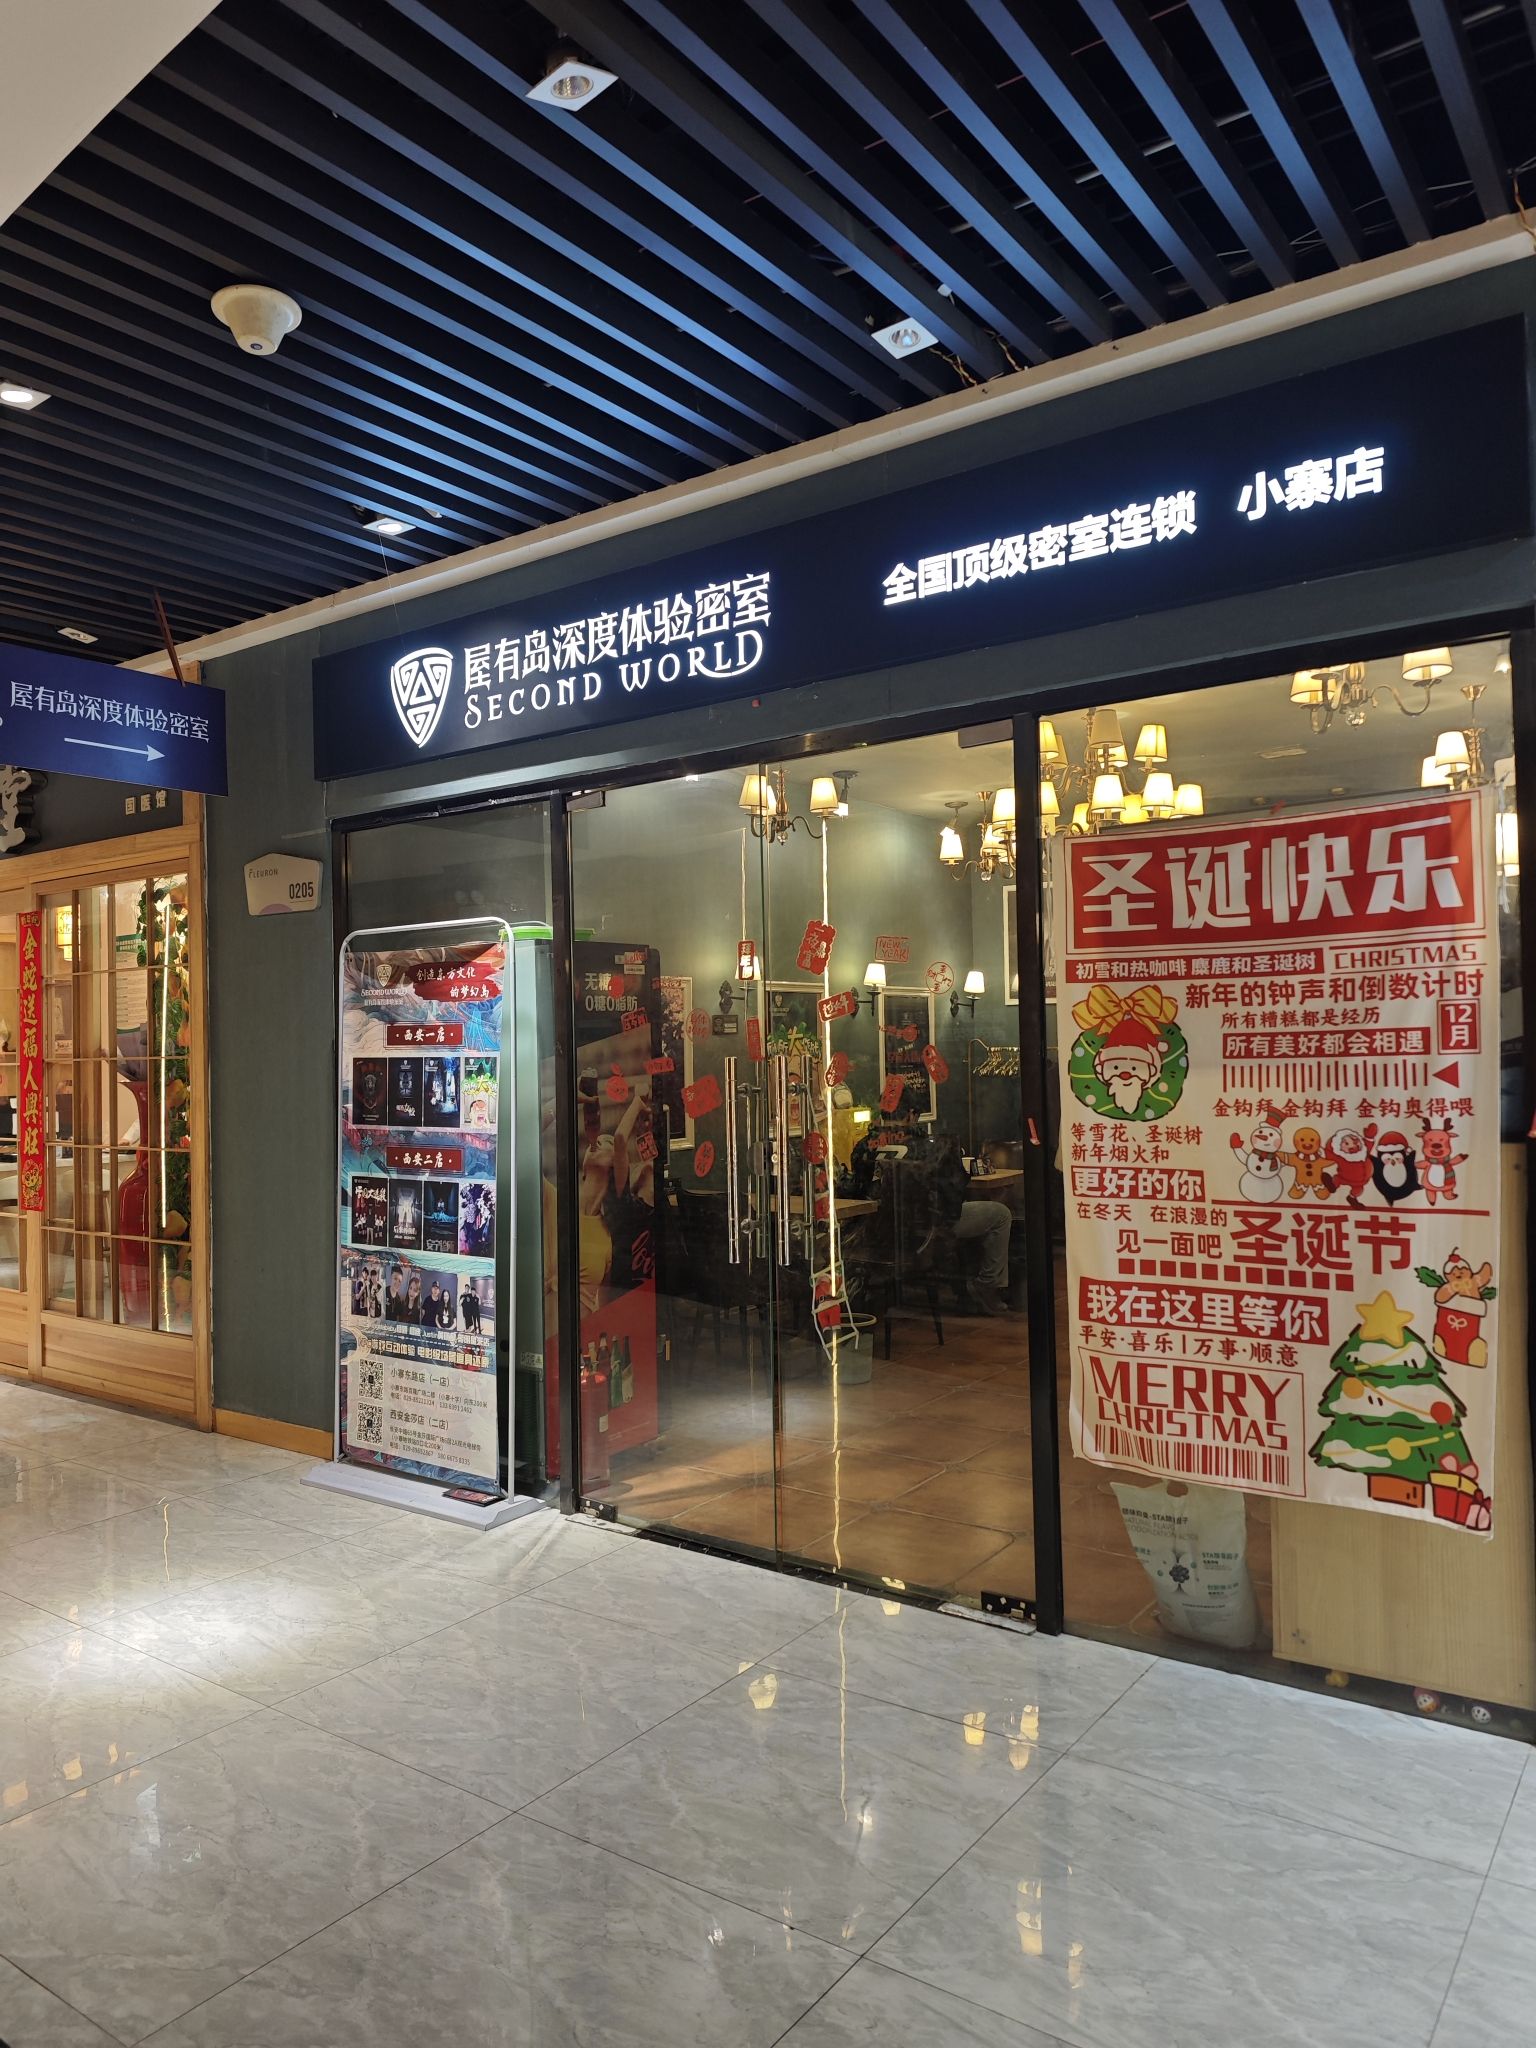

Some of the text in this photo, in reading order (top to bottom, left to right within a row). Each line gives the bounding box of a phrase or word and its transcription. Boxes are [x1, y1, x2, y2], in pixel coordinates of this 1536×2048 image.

[882, 446, 1385, 606] 全国顶级密室连锁 小寨店
[464, 571, 772, 695] 屋有岛深度体验密室
[464, 629, 763, 729] SECOND WORLD
[10, 680, 209, 743] 屋有岛深度体验密室
[1082, 815, 1463, 934] 圣诞快乐
[289, 881, 314, 900] 0205
[1076, 960, 1187, 979] 初雪和热咖啡
[1334, 943, 1478, 970] CHRISTMAS
[585, 995, 638, 1012] 0糖0脂肪
[1185, 969, 1484, 1009] 新年的钟声和倒数计时
[1220, 1006, 1380, 1029] 所有糟糕都是经历
[1445, 1004, 1473, 1023] 12
[1225, 1030, 1425, 1057] 所有美好都会相遇
[1450, 1025, 1472, 1047] 月
[1282, 1098, 1348, 1118] 金钩拜
[1355, 1097, 1475, 1119] 金钩奥得喂
[1071, 1122, 1203, 1145] 等雪花、圣诞树
[1071, 1143, 1170, 1164] 新年烟火和
[1072, 1168, 1202, 1200] 更好的你
[1077, 1203, 1416, 1275] 在冬天 在浪漫的 圣诞节
[1116, 1229, 1223, 1260] 见一面吧
[1087, 1284, 1322, 1341] 我在这里等你
[1089, 1356, 1291, 1421] MERRY
[1098, 1396, 1288, 1450] CHRISTMAS
